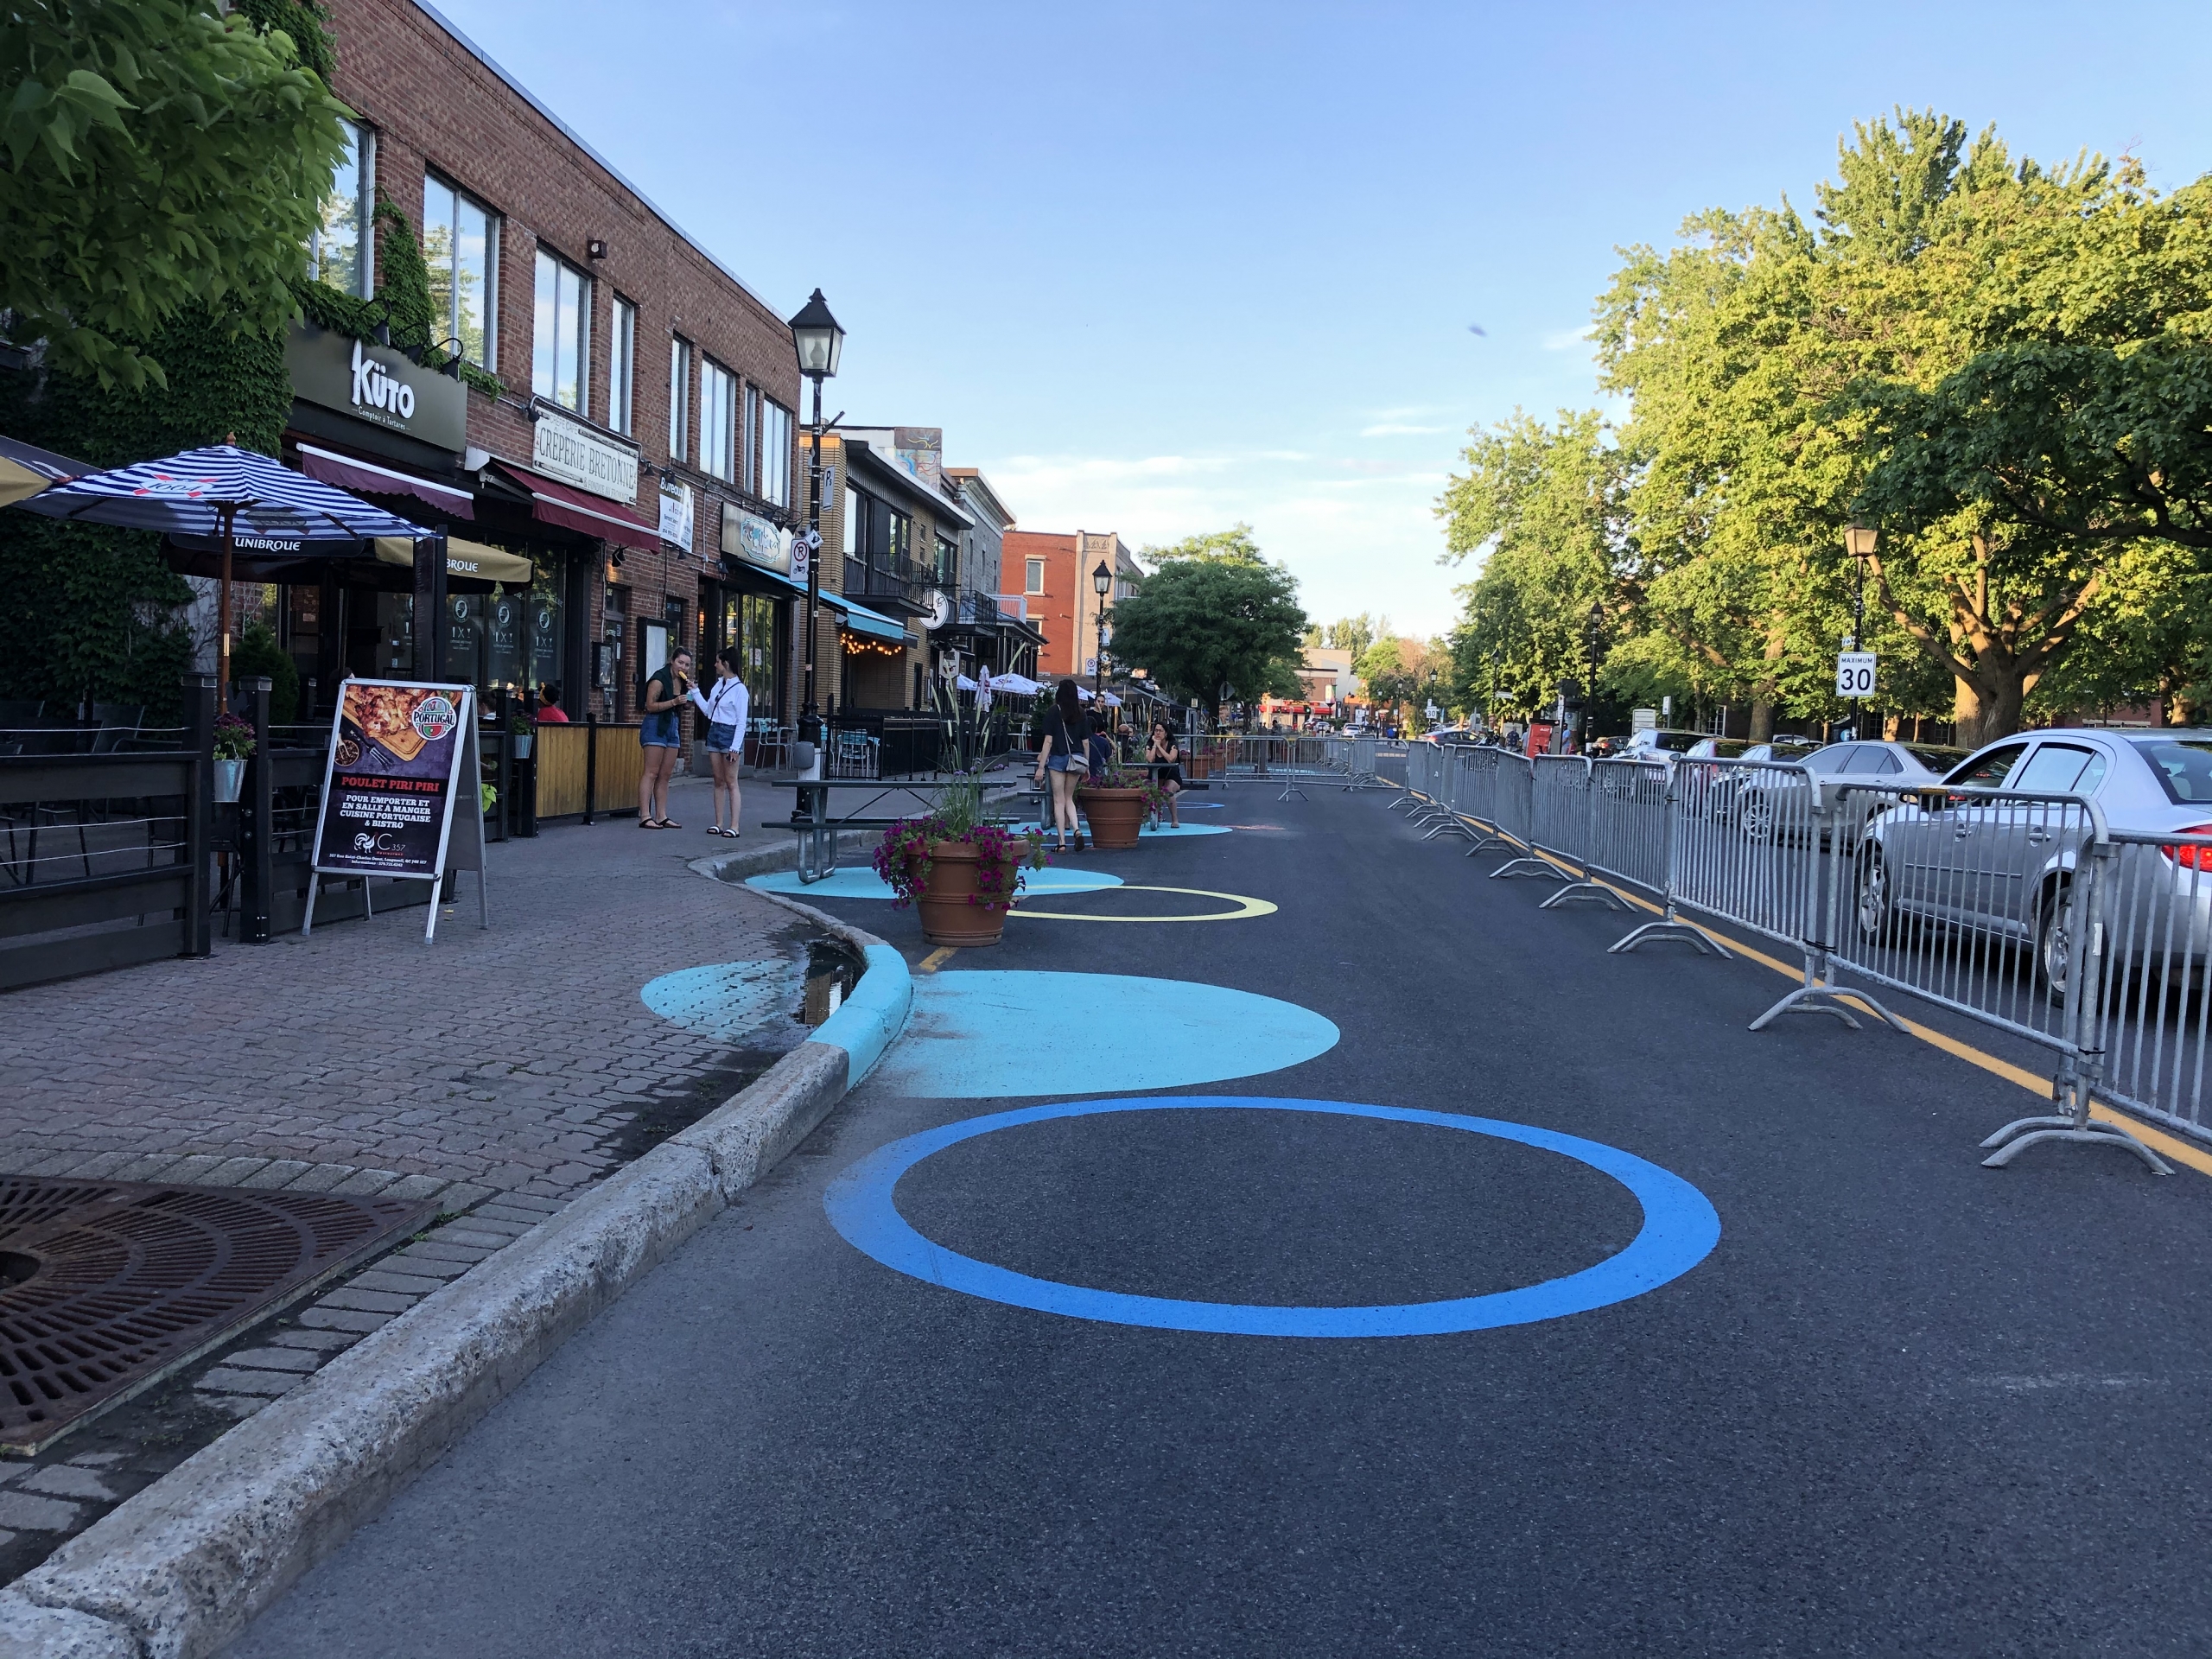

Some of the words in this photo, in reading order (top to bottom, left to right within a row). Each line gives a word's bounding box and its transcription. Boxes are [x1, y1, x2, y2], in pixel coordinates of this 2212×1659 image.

[352, 339, 415, 419] KÜTO
[358, 406, 382, 421] Comptoir
[387, 416, 405, 430] Tartares
[539, 427, 586, 472] CRÊPERIE
[589, 448, 634, 490] BRETONNE
[235, 537, 301, 551] UNIBROUE
[1841, 669, 1871, 691] 30
[414, 711, 454, 726] PORTUGAL
[341, 777, 387, 788] POULET
[389, 779, 413, 791] PIRI
[415, 782, 440, 792] PIRI
[371, 796, 416, 806] EMPORTER
[340, 810, 375, 819] CUISINE
[376, 812, 431, 823] PORTUGAISE
[385, 804, 391, 812] À
[392, 805, 431, 815] MANGER
[372, 820, 404, 829] BISTRO
